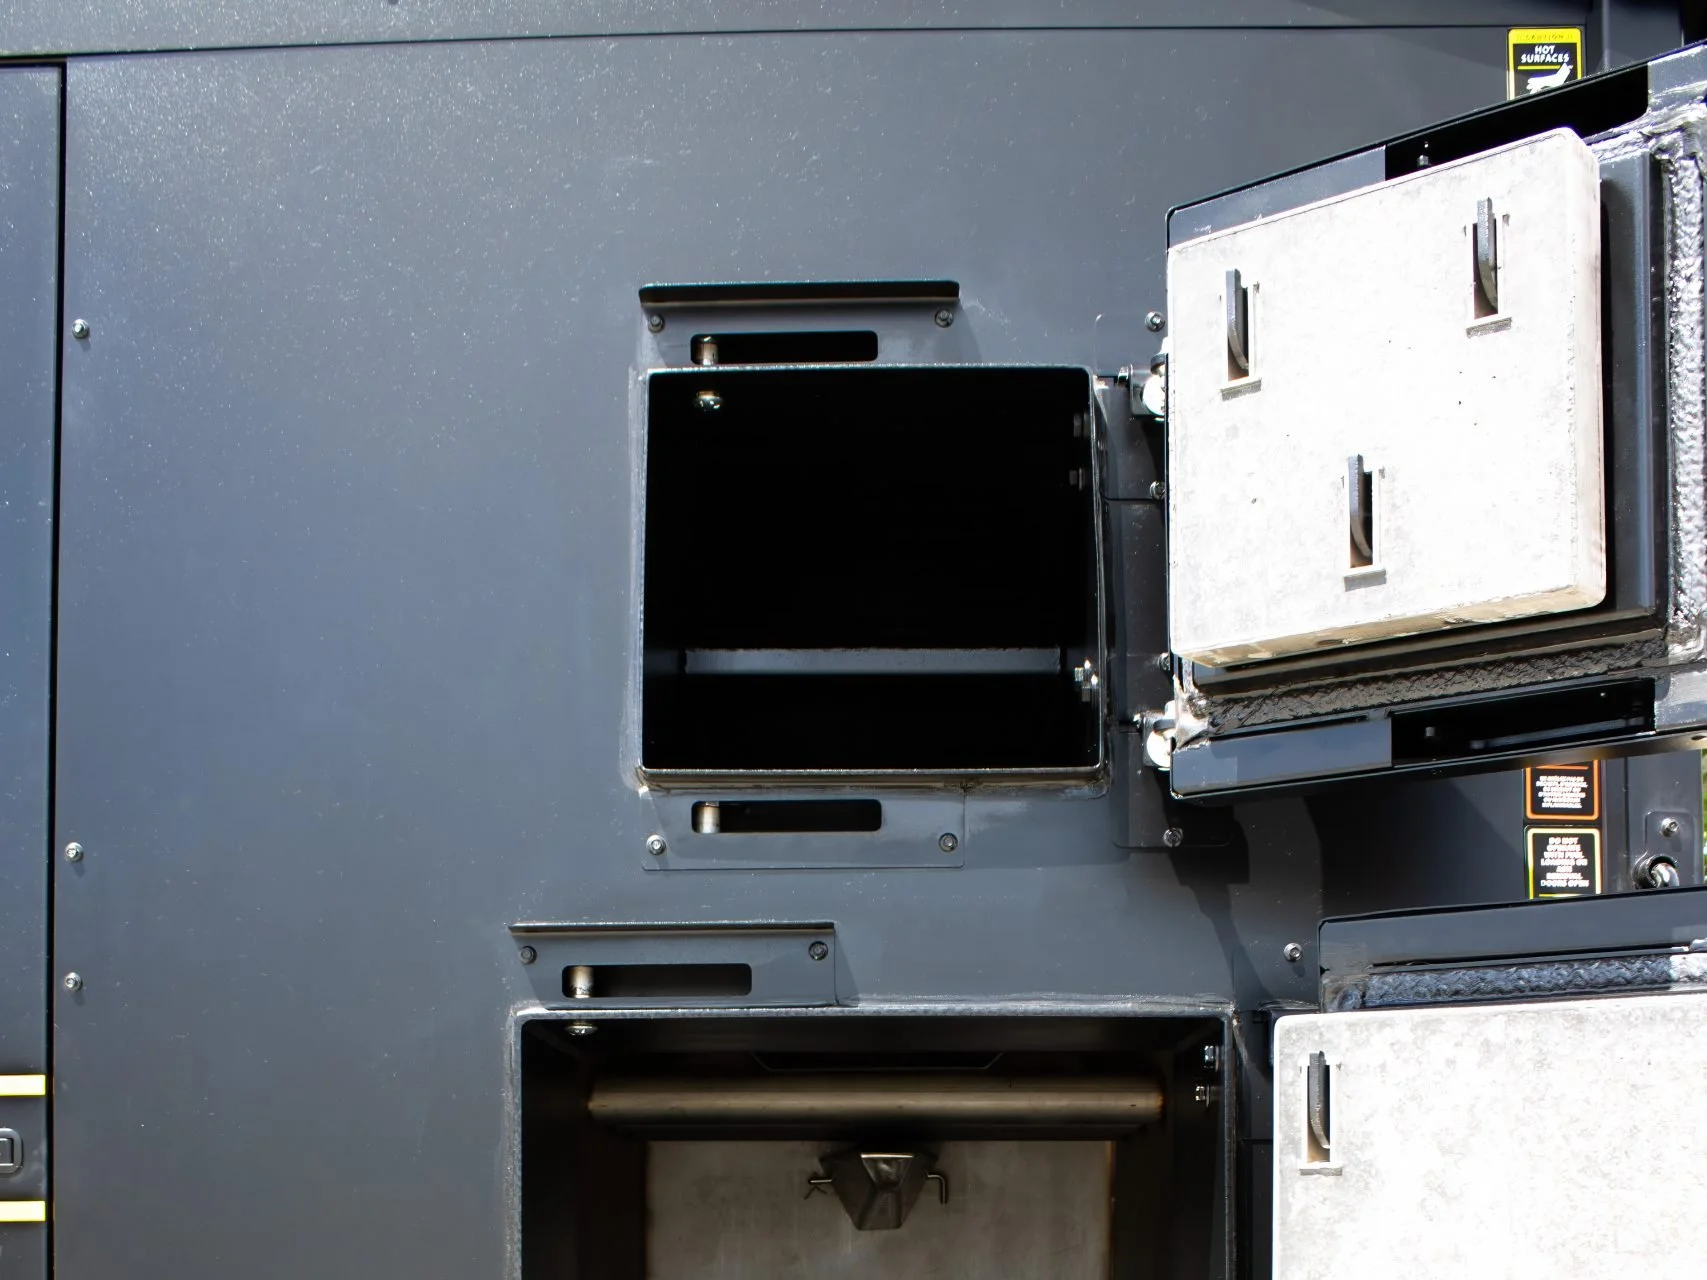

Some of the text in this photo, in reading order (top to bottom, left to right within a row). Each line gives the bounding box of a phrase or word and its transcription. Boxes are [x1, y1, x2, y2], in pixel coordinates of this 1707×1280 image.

[1534, 44, 1556, 54] HOT
[1521, 53, 1570, 63] SURFACES
[1548, 837, 1579, 845] DO NOT
